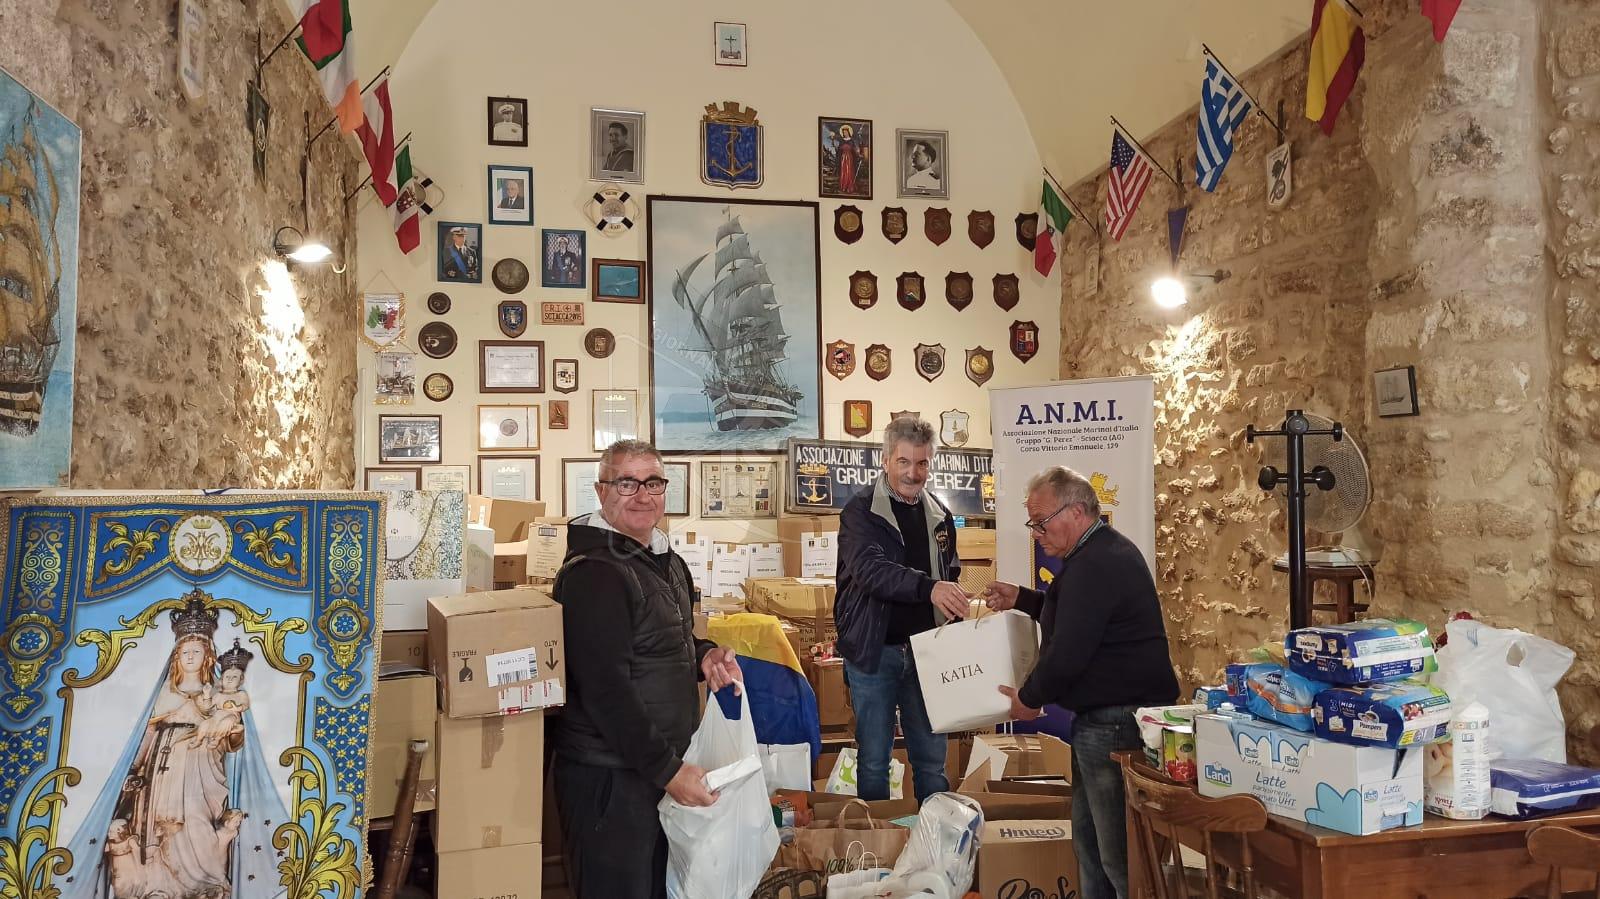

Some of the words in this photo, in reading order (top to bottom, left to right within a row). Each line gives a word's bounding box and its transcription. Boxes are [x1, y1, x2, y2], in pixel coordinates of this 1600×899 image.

[1016, 400, 1123, 425] A.N.M.I.
[1003, 429, 1046, 437] Associazione
[1047, 427, 1082, 435] Nazionale
[1114, 425, 1139, 433] d'Italia
[1016, 437, 1042, 445] Gruppo
[1081, 434, 1108, 442] Sciacca
[1108, 434, 1125, 442] (AG)
[1041, 444, 1068, 452] Vittorio
[796, 446, 866, 466] ASSOCIAZIONE
[931, 454, 971, 473] MARINAI
[452, 649, 477, 657] FRAGILE
[941, 663, 984, 684] KATIA
[1360, 722, 1381, 730] Pampers
[1205, 765, 1231, 783] Land
[1256, 772, 1287, 788] Latte
[1278, 797, 1297, 807] UHT
[826, 858, 854, 873] 100%
